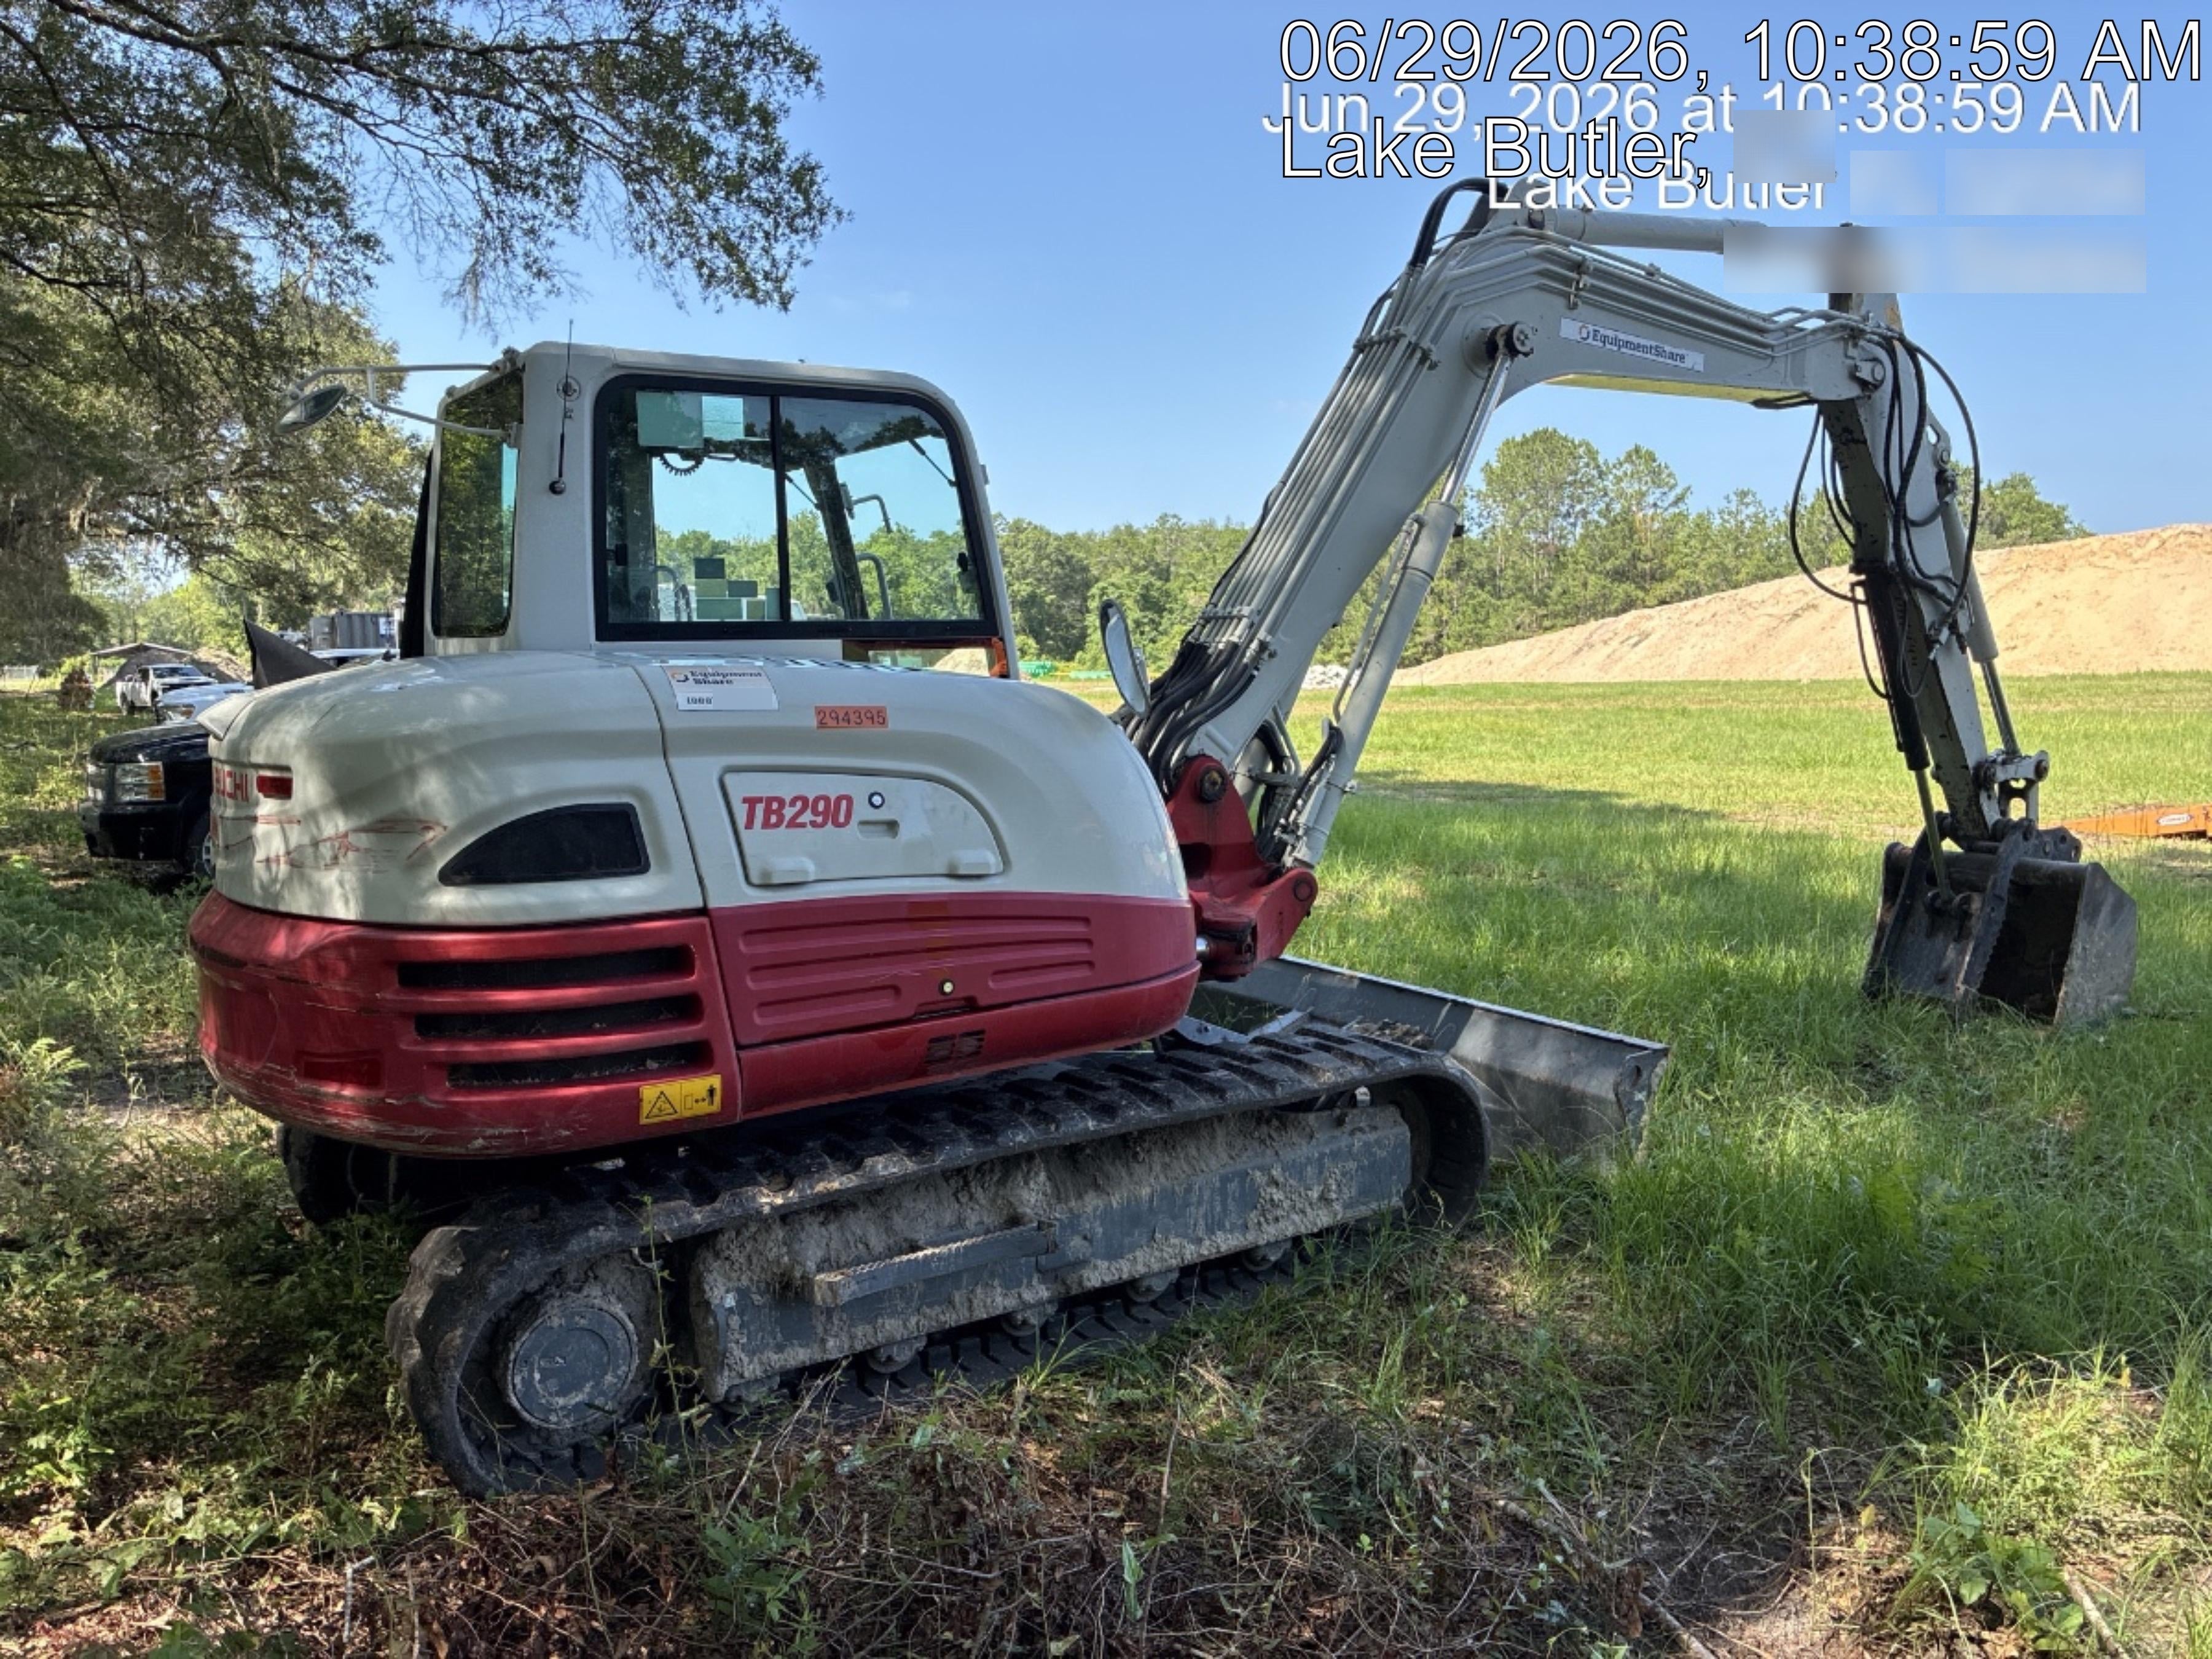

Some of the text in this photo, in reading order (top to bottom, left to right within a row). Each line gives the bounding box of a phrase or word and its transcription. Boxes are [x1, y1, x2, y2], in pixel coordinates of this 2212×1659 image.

[1592, 329, 1686, 364] EquipmentShare
[817, 708, 885, 726] 294395
[742, 794, 854, 830] TB290
